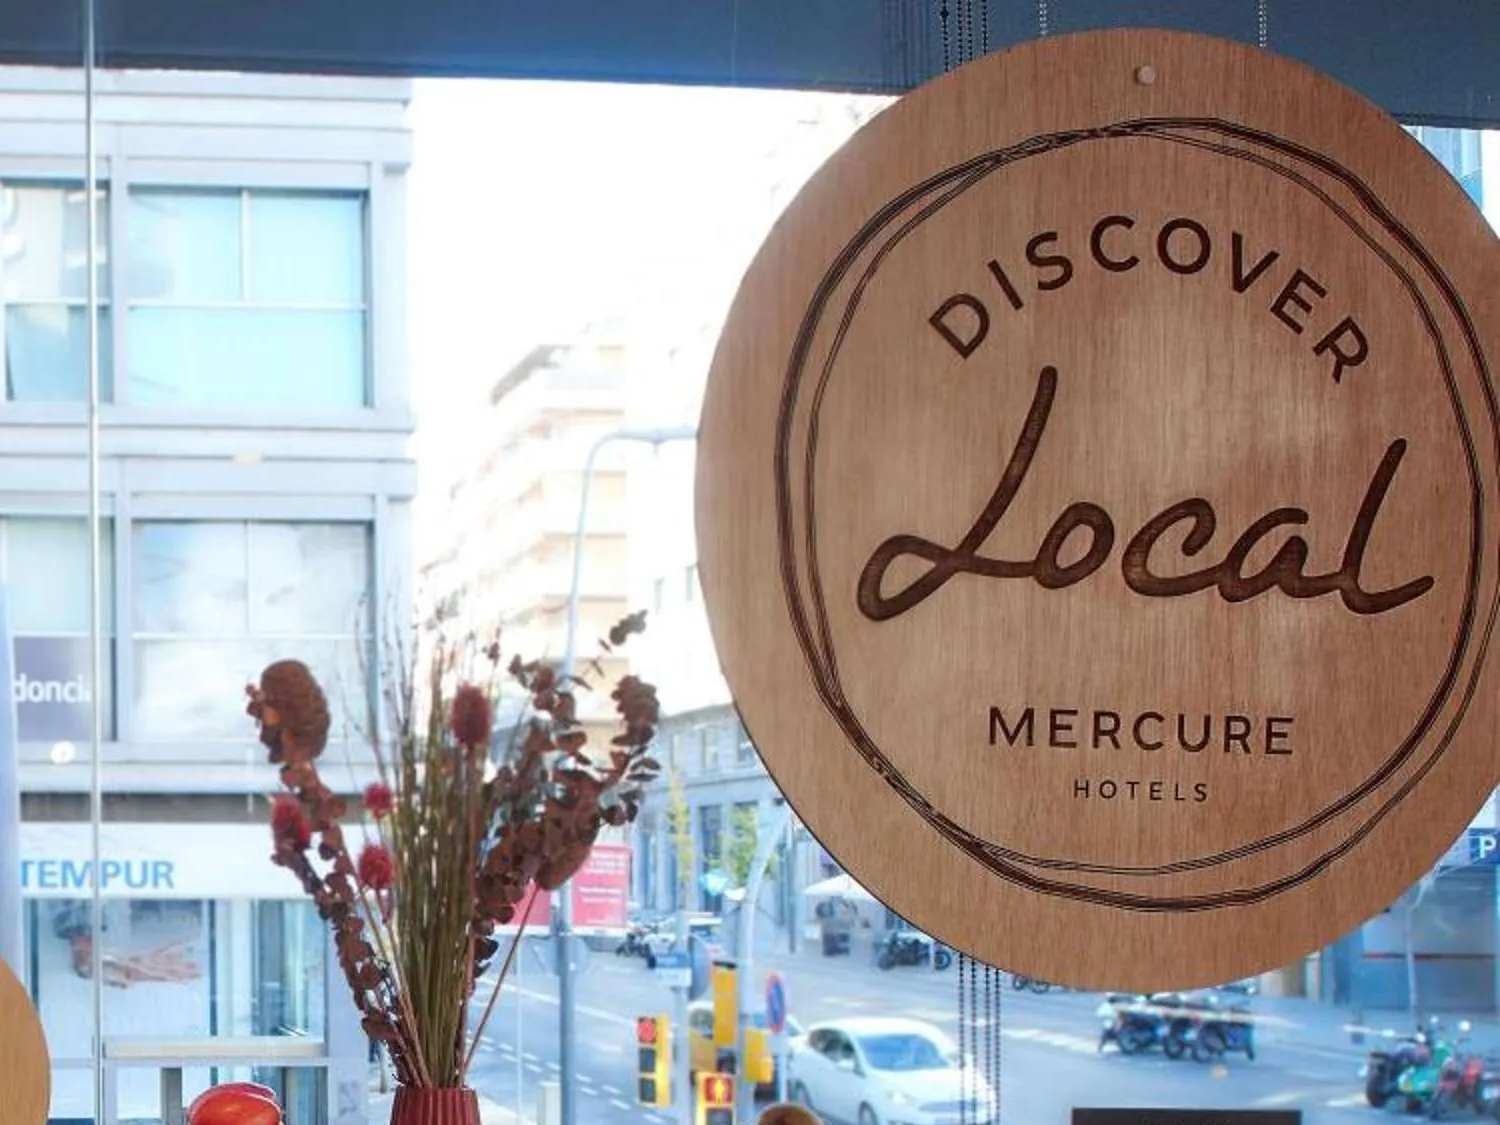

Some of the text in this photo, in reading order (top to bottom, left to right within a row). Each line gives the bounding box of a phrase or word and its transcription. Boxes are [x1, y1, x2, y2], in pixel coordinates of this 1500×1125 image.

[928, 214, 1369, 383] DISCOVER
[857, 365, 1435, 623] Local
[988, 705, 1296, 756] MERCURE
[1073, 779, 1209, 803] HOTELS
[1479, 834, 1497, 859] P
